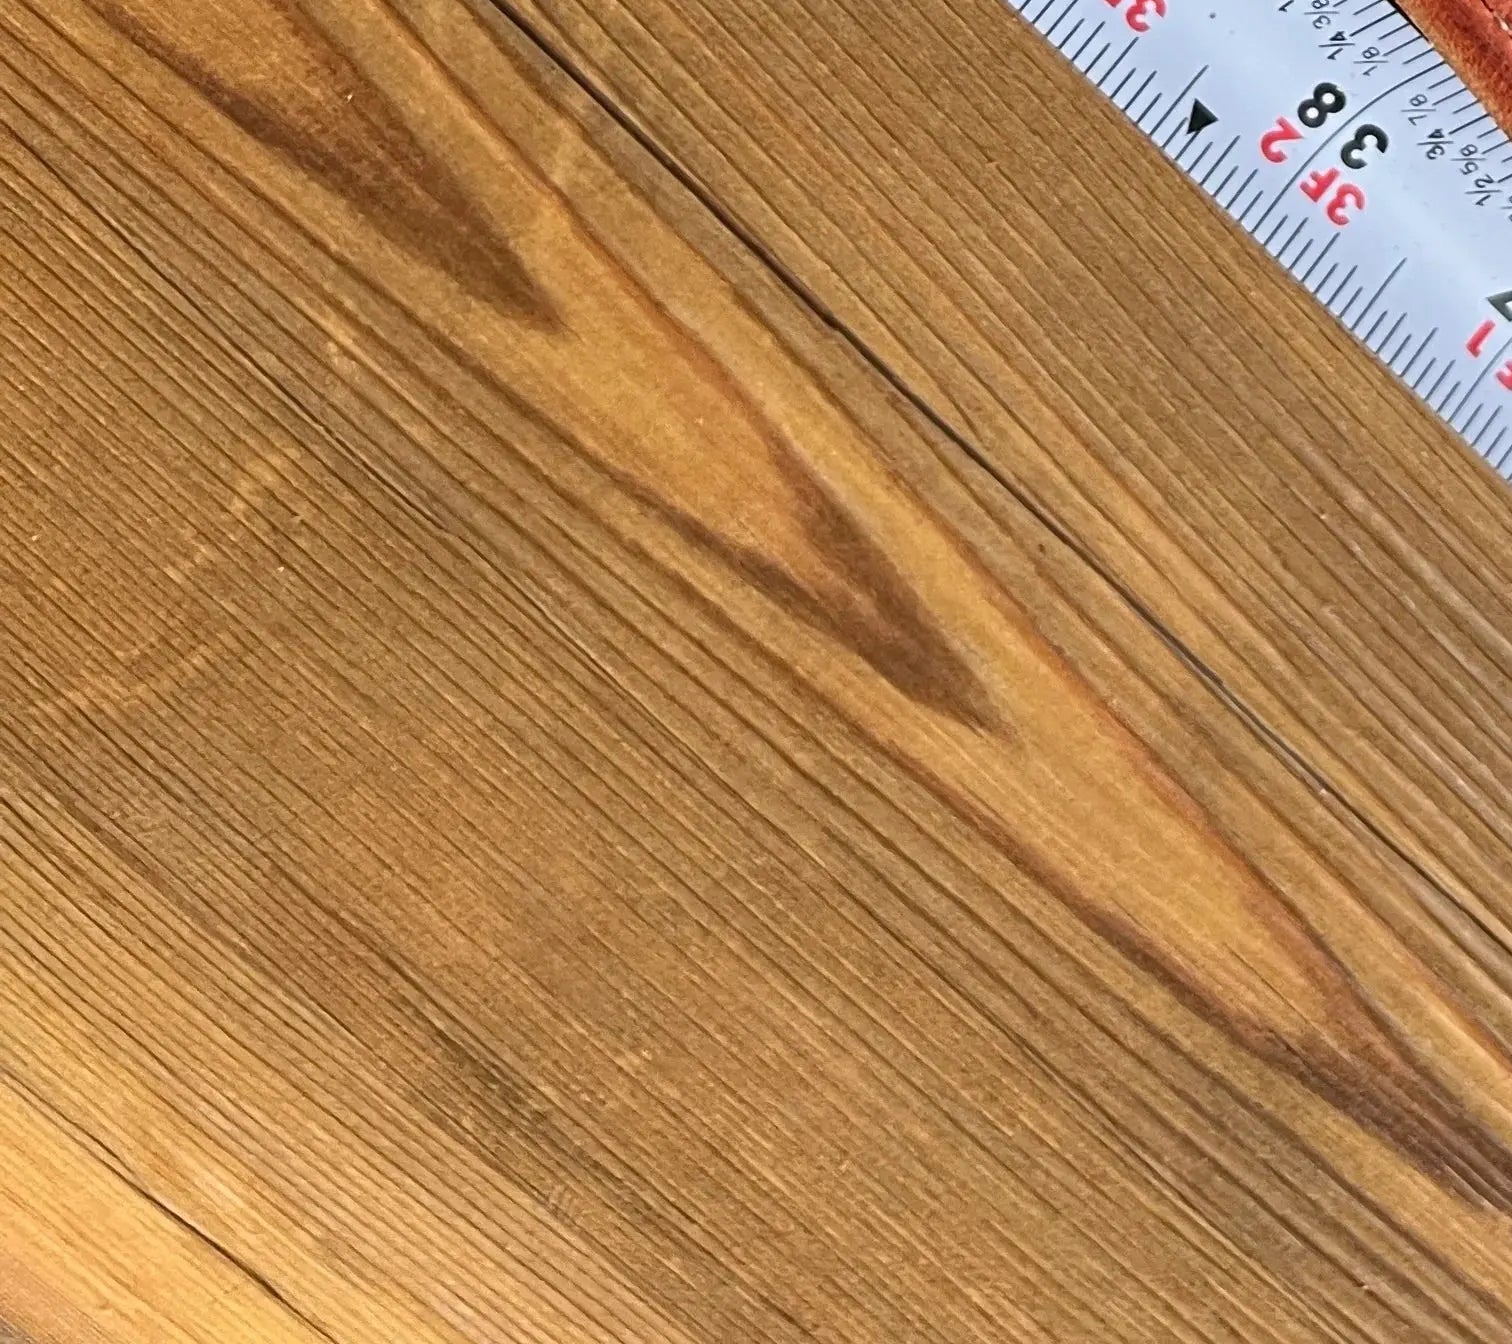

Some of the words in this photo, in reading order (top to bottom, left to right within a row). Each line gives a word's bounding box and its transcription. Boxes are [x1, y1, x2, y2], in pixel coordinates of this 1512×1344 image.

[1319, 31, 1355, 60] 1/4
[1354, 47, 1388, 76] 1/8
[1402, 94, 1435, 125] 7/8
[1261, 118, 1302, 163] 2
[1297, 83, 1388, 169] 38
[1417, 129, 1453, 160] 3/4
[1453, 144, 1485, 175] 5/8
[1466, 174, 1501, 206] 1/2
[1467, 322, 1494, 357] 1
